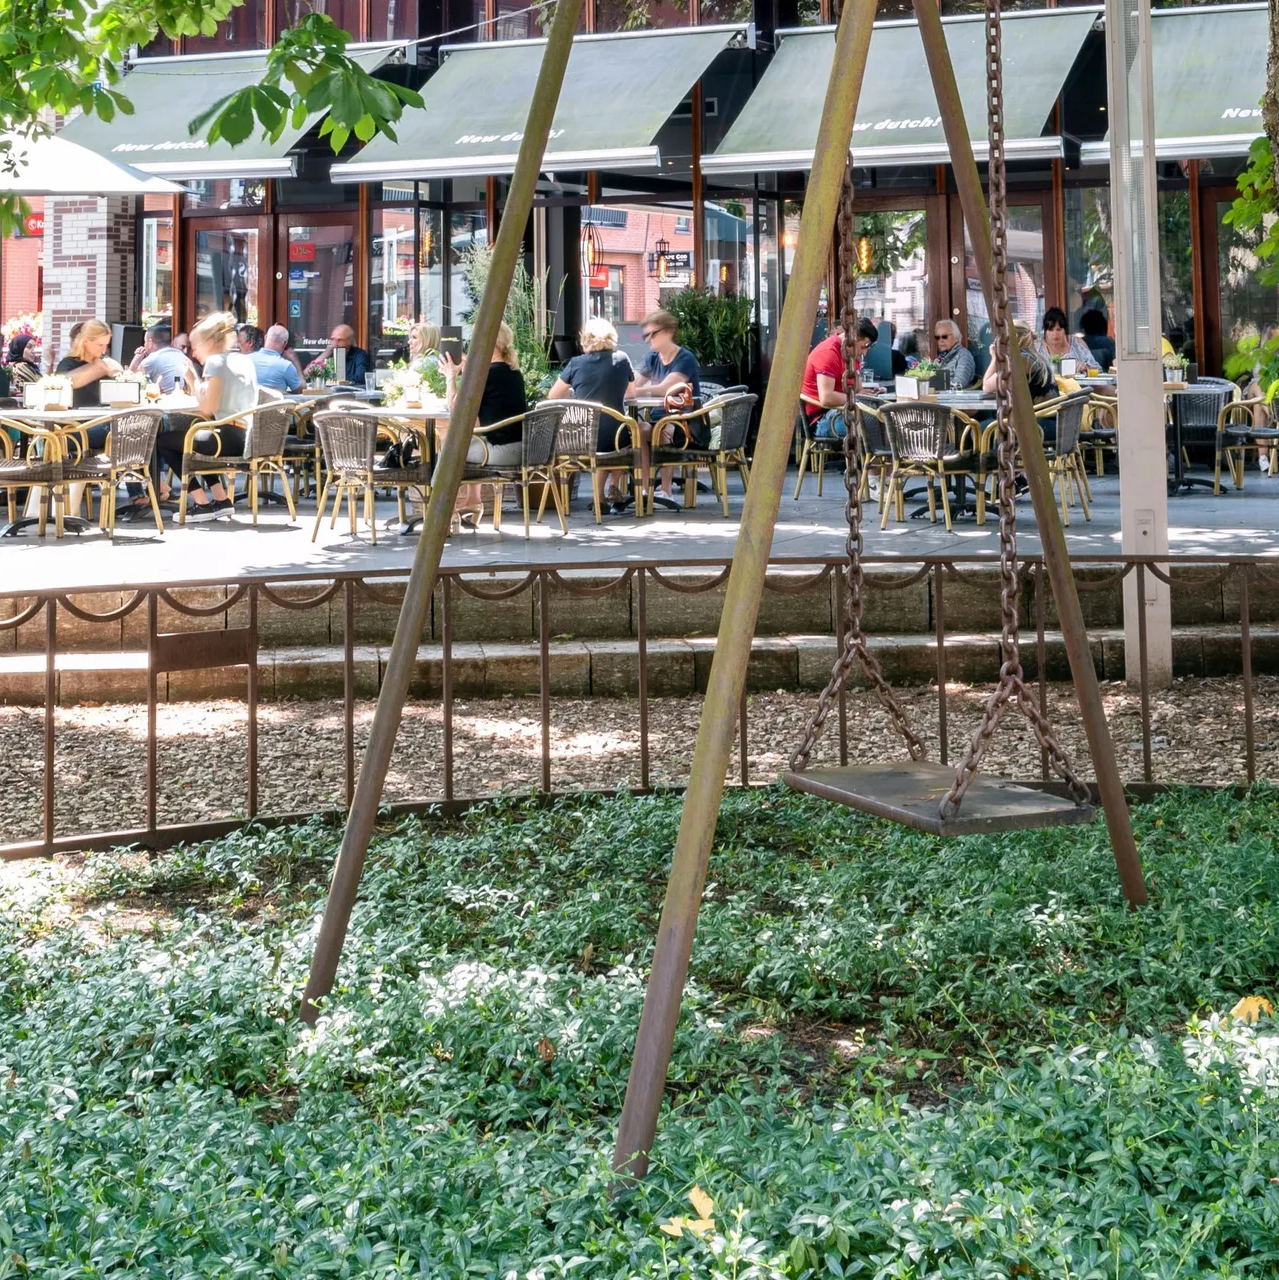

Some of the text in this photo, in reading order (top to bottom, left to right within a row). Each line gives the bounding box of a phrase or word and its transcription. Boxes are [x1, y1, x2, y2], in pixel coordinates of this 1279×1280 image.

[1221, 107, 1263, 119] New
[874, 116, 941, 131] dutch!
[455, 134, 501, 145] New
[111, 143, 154, 153] New
